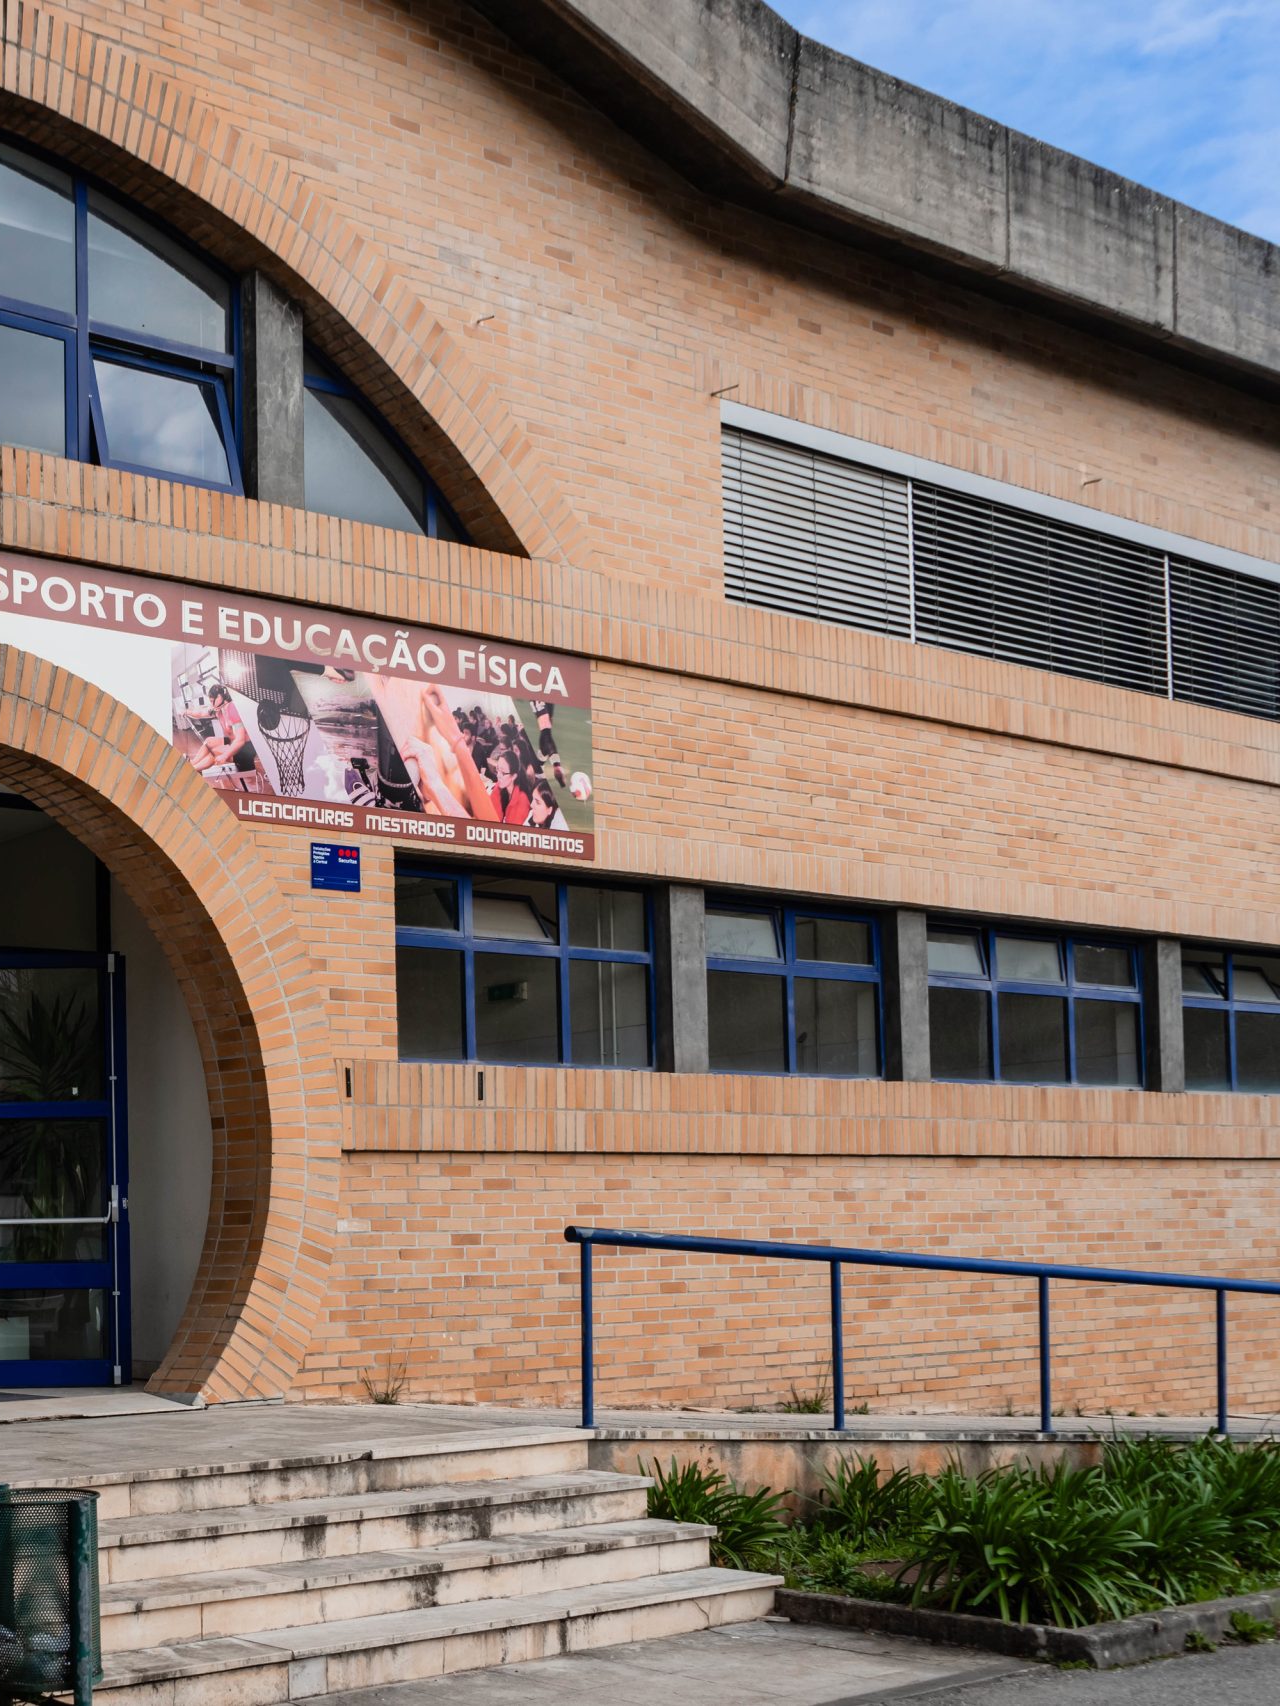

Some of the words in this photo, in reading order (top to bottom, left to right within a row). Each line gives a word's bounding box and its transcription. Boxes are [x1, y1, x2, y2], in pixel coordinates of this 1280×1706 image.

[181, 599, 204, 636] E
[218, 605, 446, 676] EDUCAÇÃO
[457, 644, 570, 698] FÍSICA
[238, 799, 354, 828] LICENCIATURAS
[365, 814, 456, 839] MESTRADOS
[466, 825, 585, 854] DOUTORAMENTOS
[338, 857, 358, 865] Securitas
